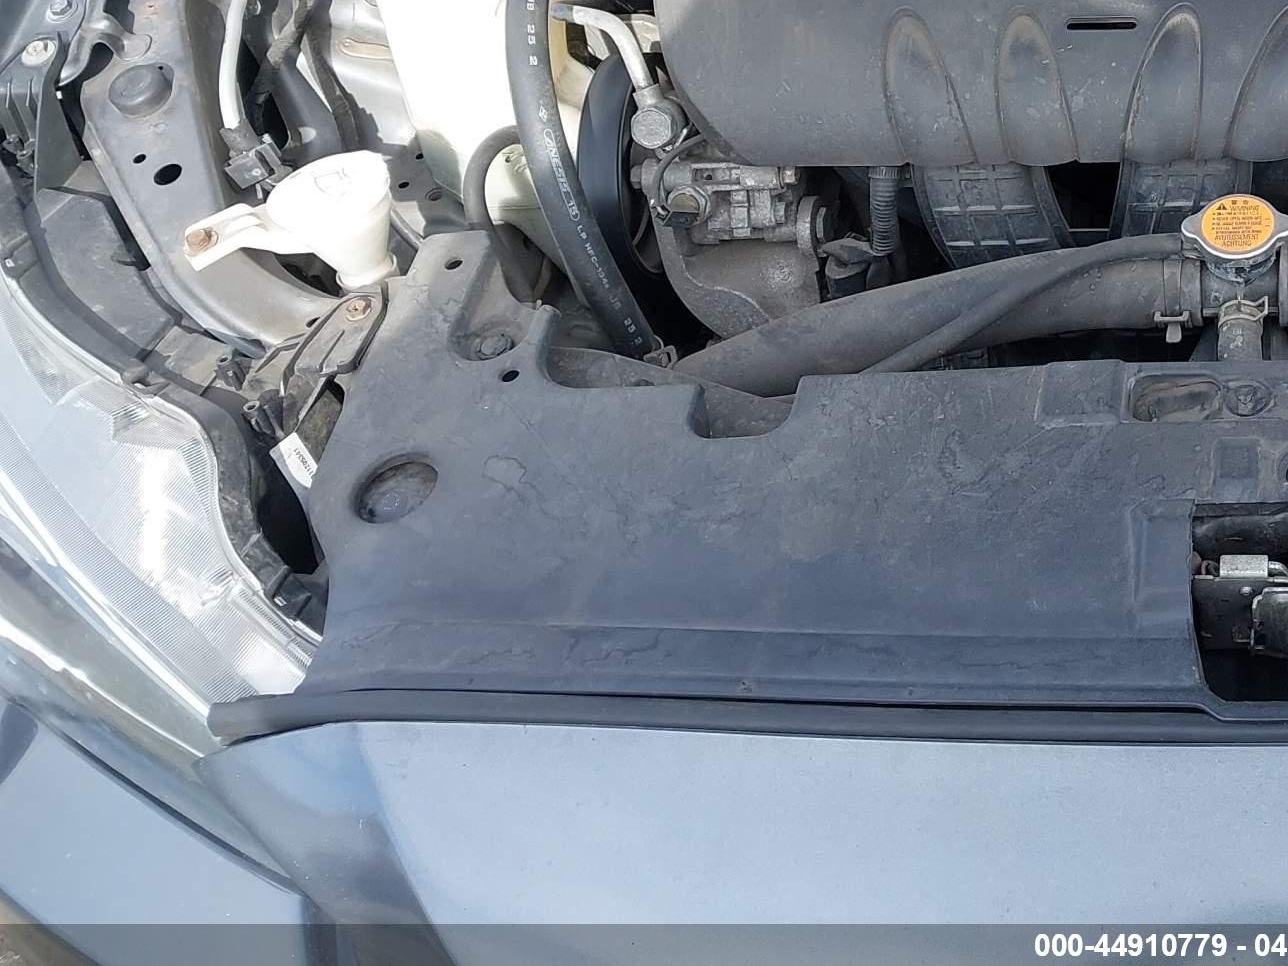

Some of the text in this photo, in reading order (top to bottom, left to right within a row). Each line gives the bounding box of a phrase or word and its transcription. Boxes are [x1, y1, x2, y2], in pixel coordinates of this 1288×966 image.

[527, 24, 537, 45] 25
[529, 55, 538, 66] 2
[624, 317, 636, 334] 25
[633, 336, 643, 346] 2
